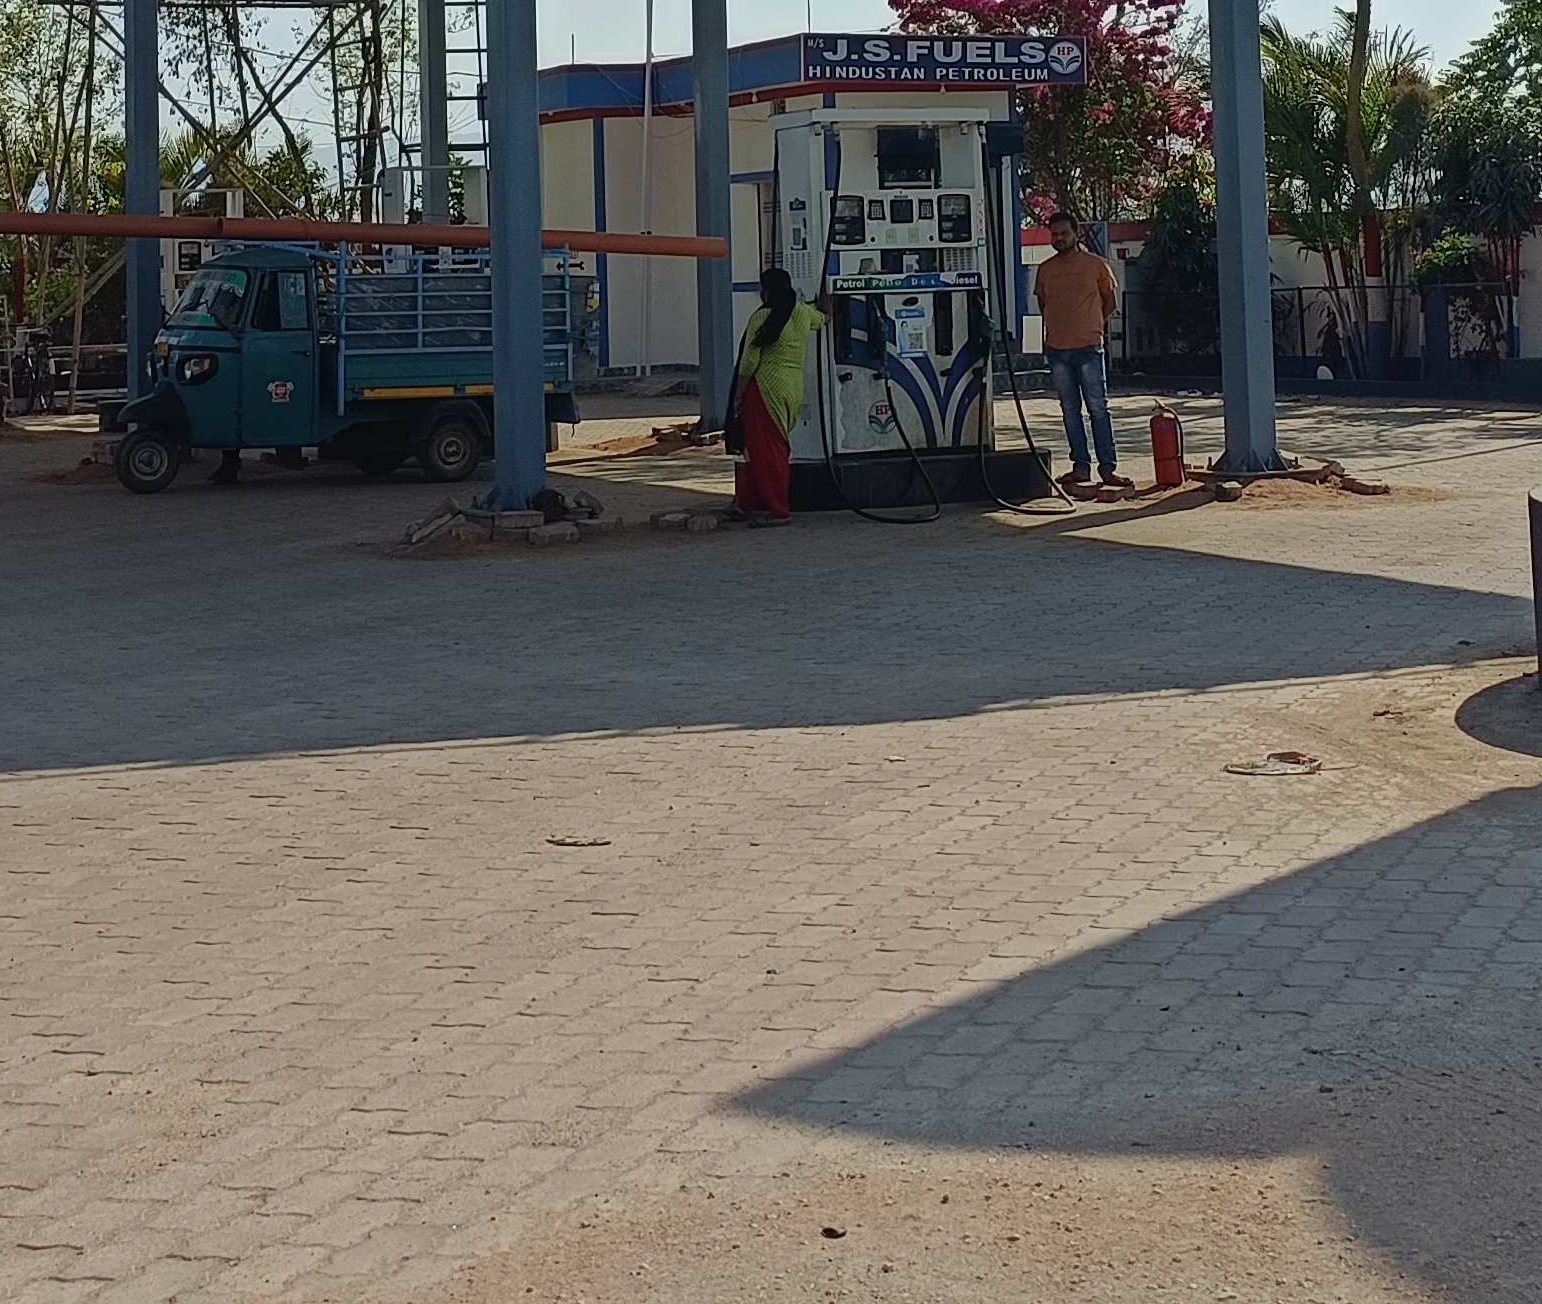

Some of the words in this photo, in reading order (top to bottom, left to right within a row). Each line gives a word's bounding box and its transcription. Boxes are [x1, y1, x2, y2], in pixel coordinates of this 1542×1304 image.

[807, 37, 825, 49] M/S
[1056, 46, 1075, 56] HP
[808, 65, 925, 80] HINDUSTAN
[935, 67, 1049, 81] PETROLEUM
[836, 278, 865, 289] Petrol
